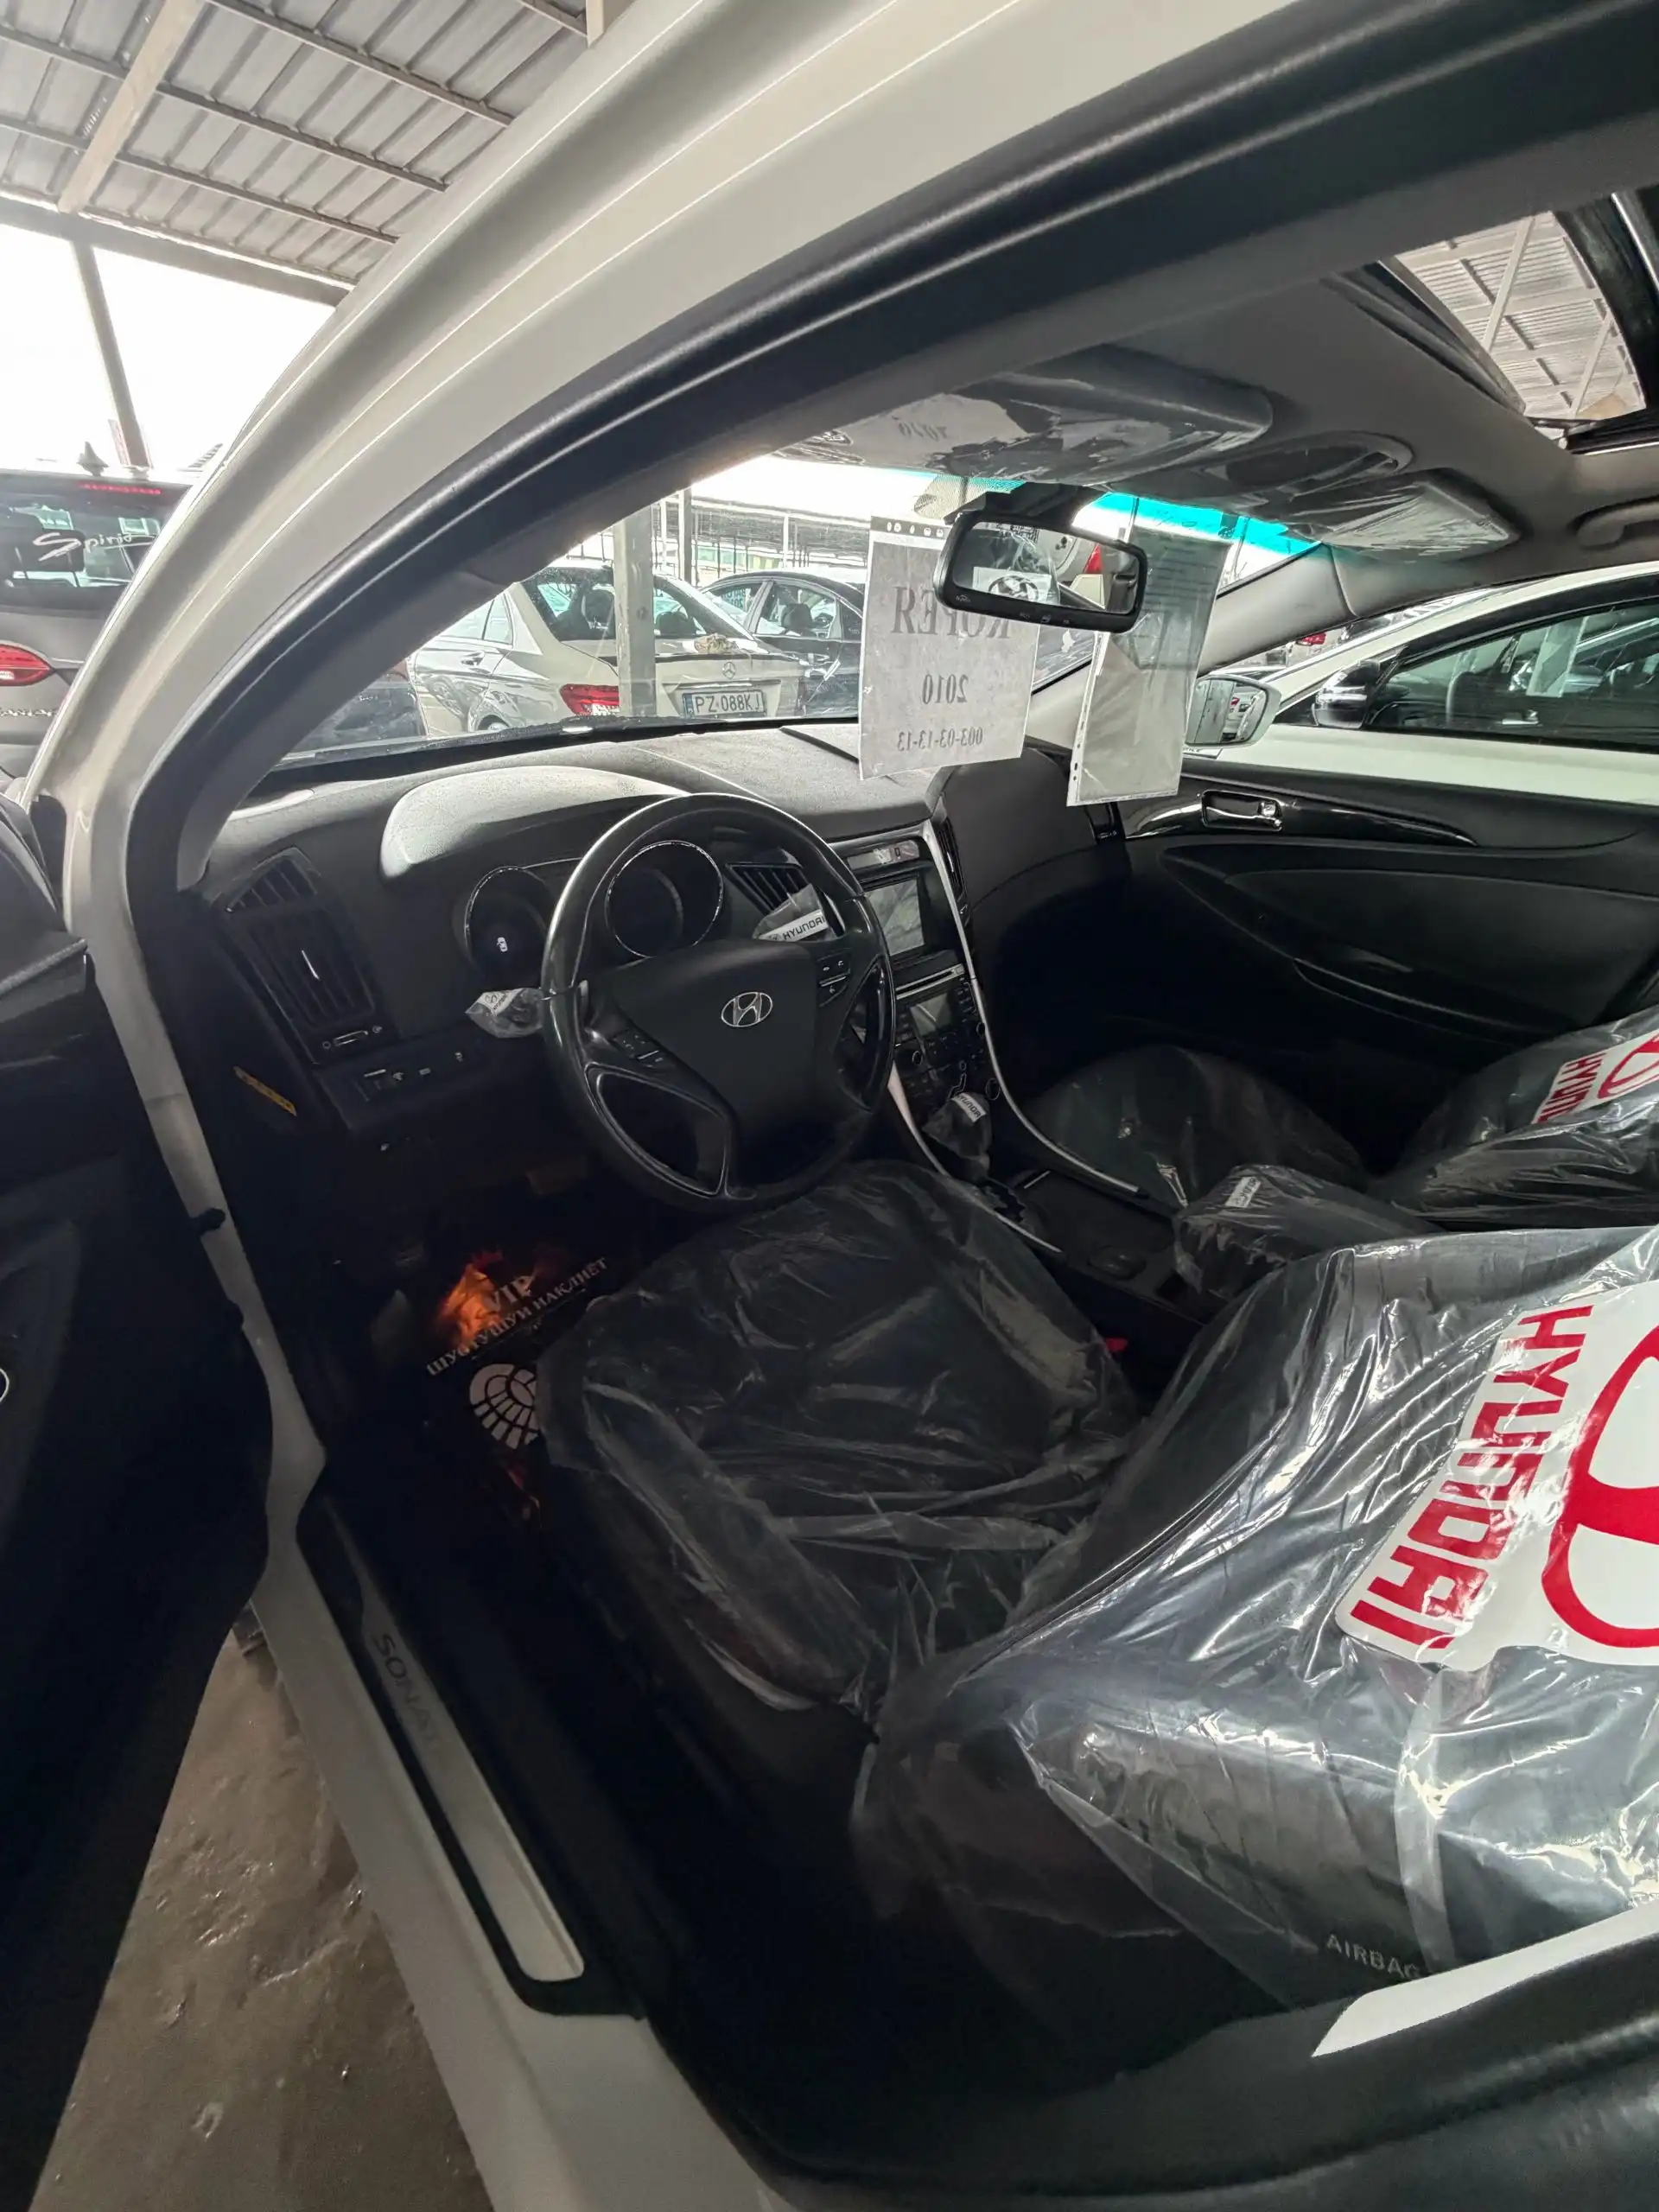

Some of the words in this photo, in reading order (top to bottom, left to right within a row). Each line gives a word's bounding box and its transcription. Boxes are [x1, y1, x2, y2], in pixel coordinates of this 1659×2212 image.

[782, 916, 826, 940] HYUNDAI
[957, 1094, 982, 1117] HYUNDA
[1351, 1304, 1594, 1649] HYUNDAI
